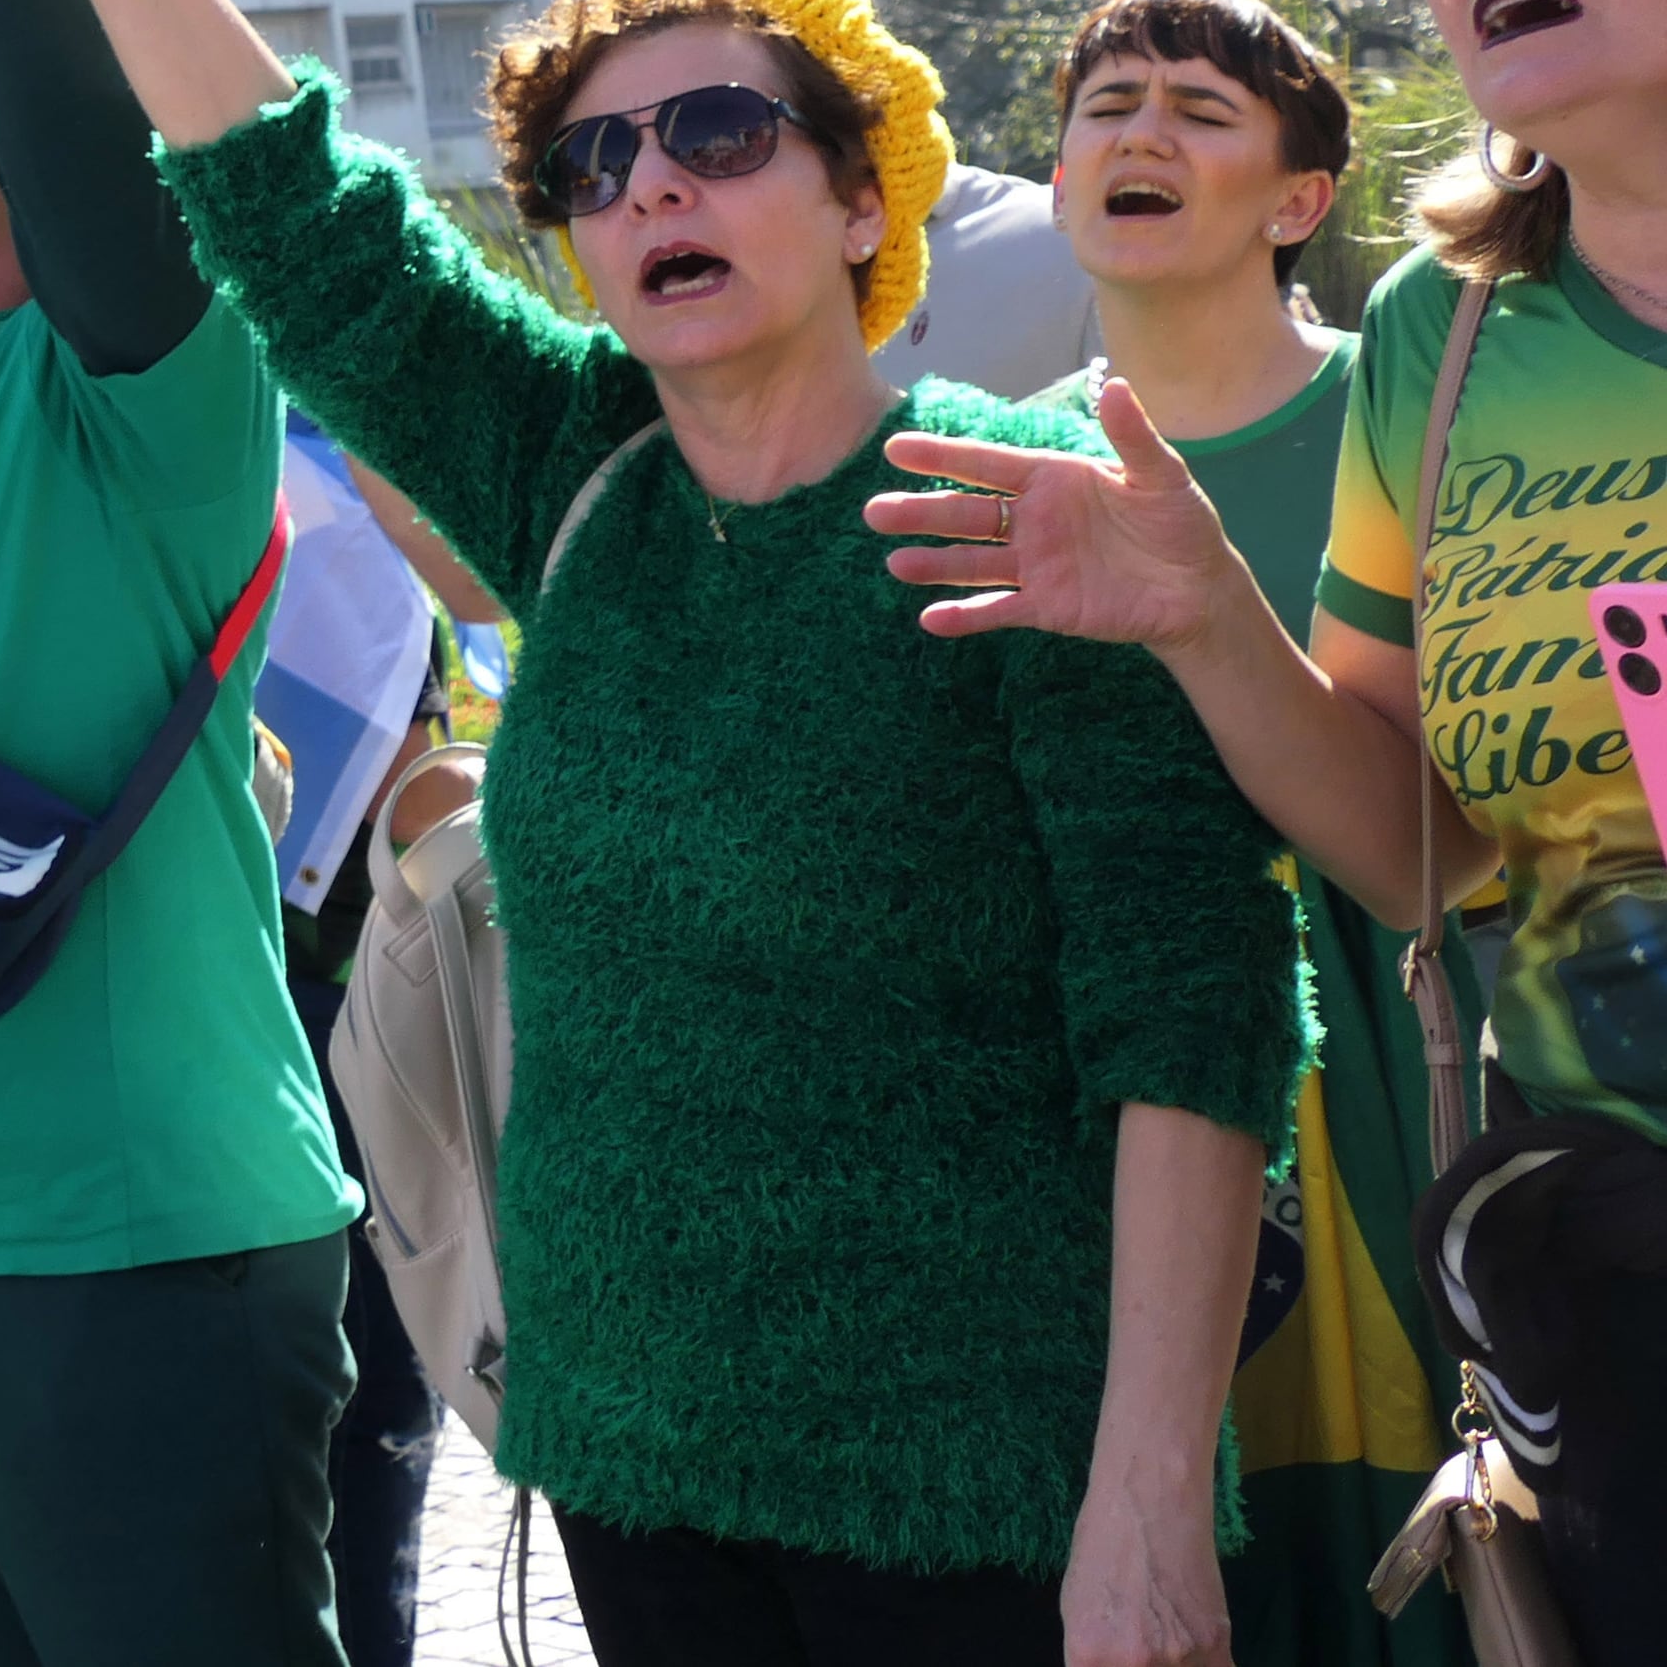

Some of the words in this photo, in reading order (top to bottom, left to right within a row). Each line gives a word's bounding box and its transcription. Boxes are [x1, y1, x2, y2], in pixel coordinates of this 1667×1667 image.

[1430, 453, 1667, 547] Deus
[1421, 611, 1608, 718] Fam
[1434, 706, 1633, 806] Libe
